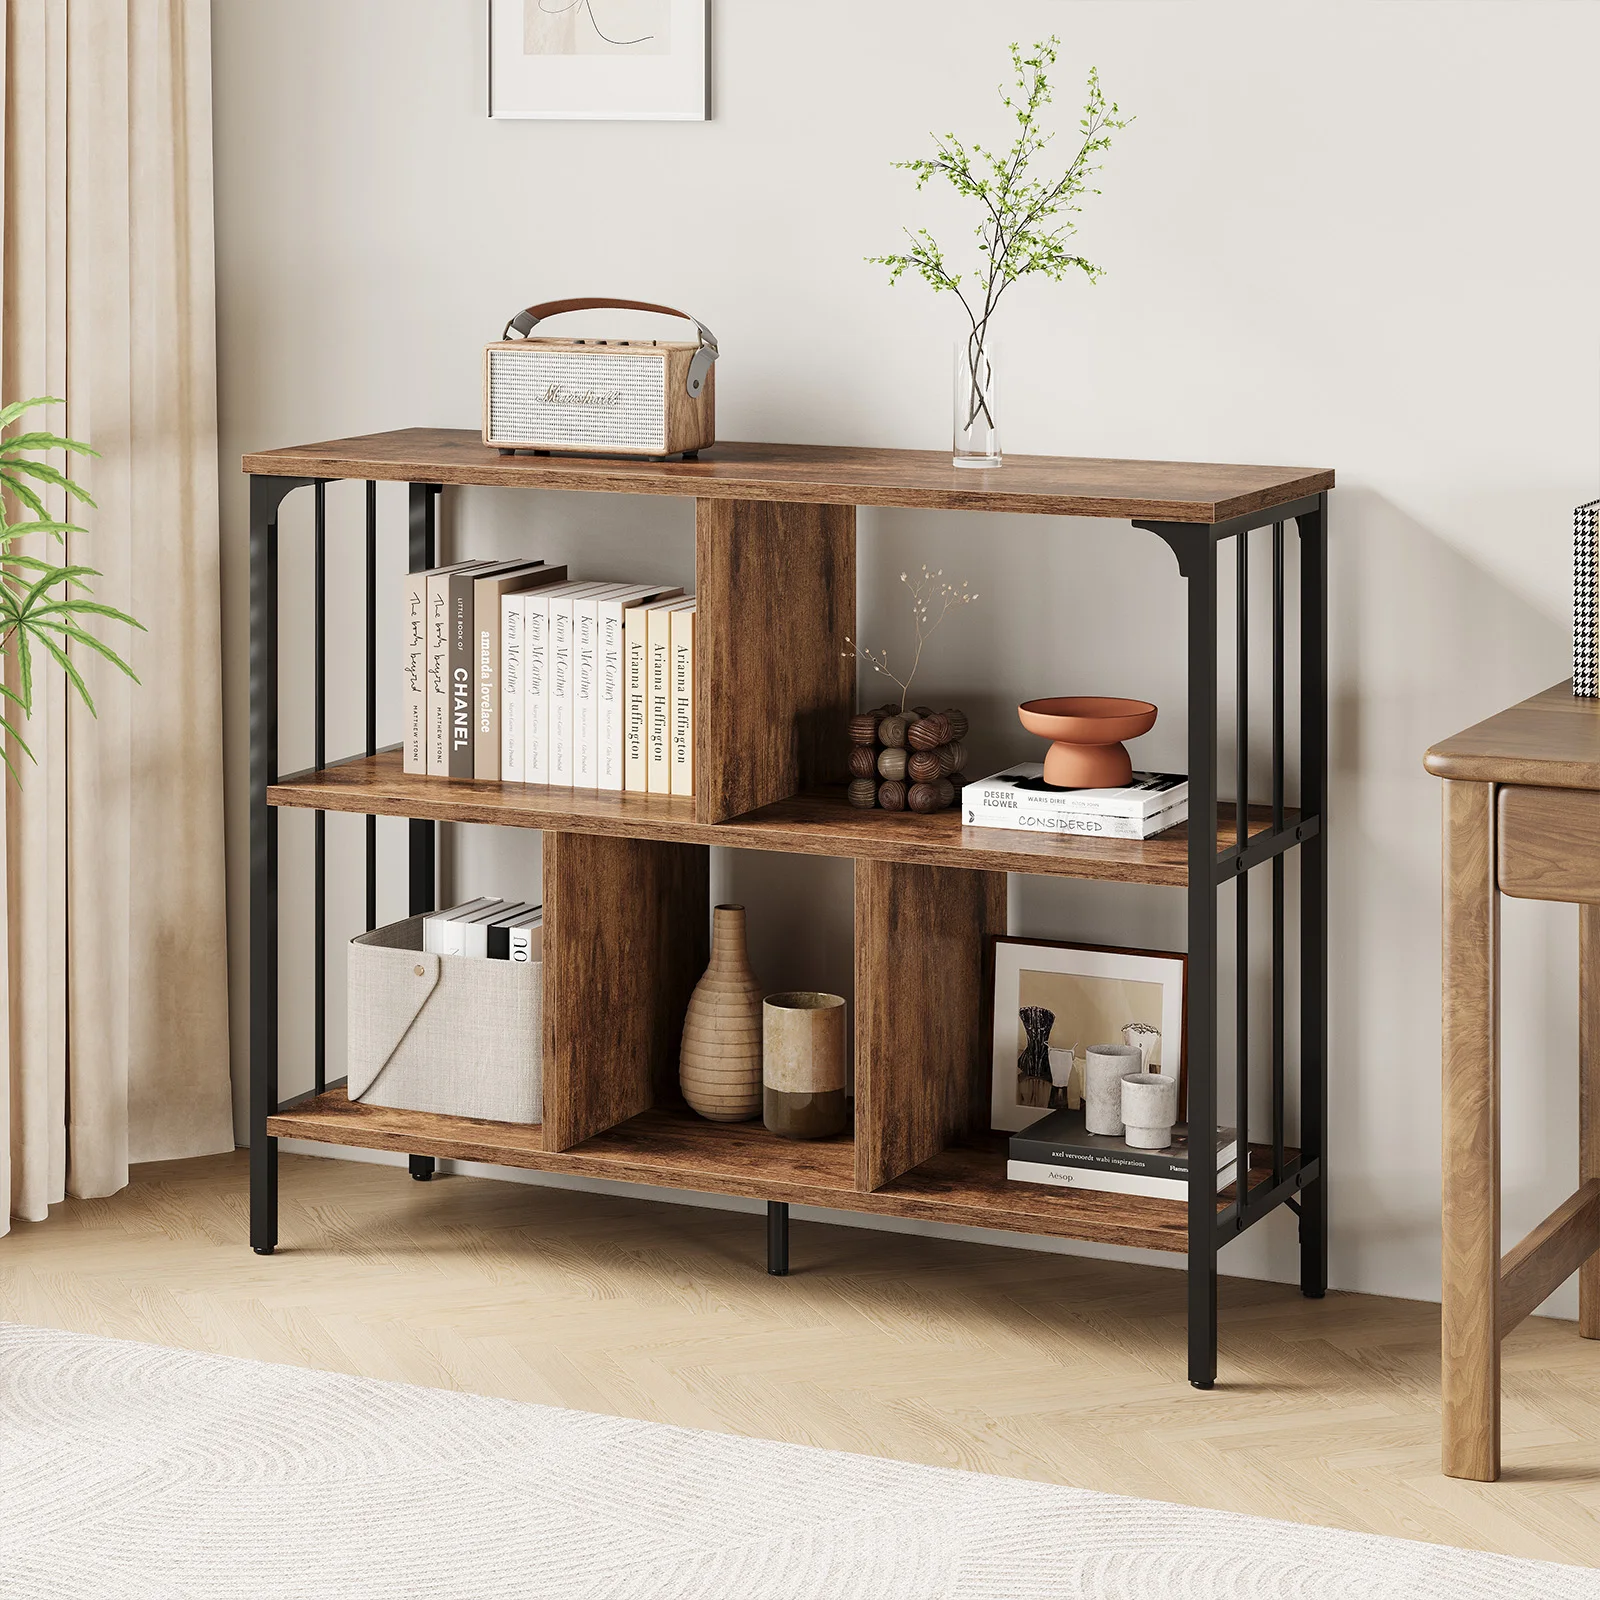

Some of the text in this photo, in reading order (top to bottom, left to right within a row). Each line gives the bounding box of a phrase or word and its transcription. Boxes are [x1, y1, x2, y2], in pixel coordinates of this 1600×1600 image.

[535, 383, 620, 405] Marshall
[404, 591, 424, 693] The body beyond
[427, 593, 448, 695] The body beyond
[508, 610, 520, 640] Karen
[532, 612, 544, 642] Karen
[556, 613, 569, 643] Karen
[581, 615, 593, 645] Karen
[605, 617, 618, 646] Karen
[457, 641, 464, 651] OF
[480, 630, 493, 733] amanda lovelace
[503, 642, 520, 695] McCartney
[528, 643, 544, 697] McCartney
[552, 645, 569, 699] McCartney
[576, 647, 593, 700] McCartney
[601, 648, 618, 702] McCartney
[453, 667, 469, 751] CHANEL
[628, 641, 643, 760] Arianna Huffington
[650, 643, 666, 762] Arianna Huffington
[673, 644, 690, 764] Arianna Huffington
[983, 790, 1015, 800] DESERT
[983, 799, 1018, 809] FLOWER
[1027, 796, 1066, 805] WARIS DIRIE
[1018, 815, 1103, 832] CONSIDERED
[1111, 1156, 1146, 1168] inspirations
